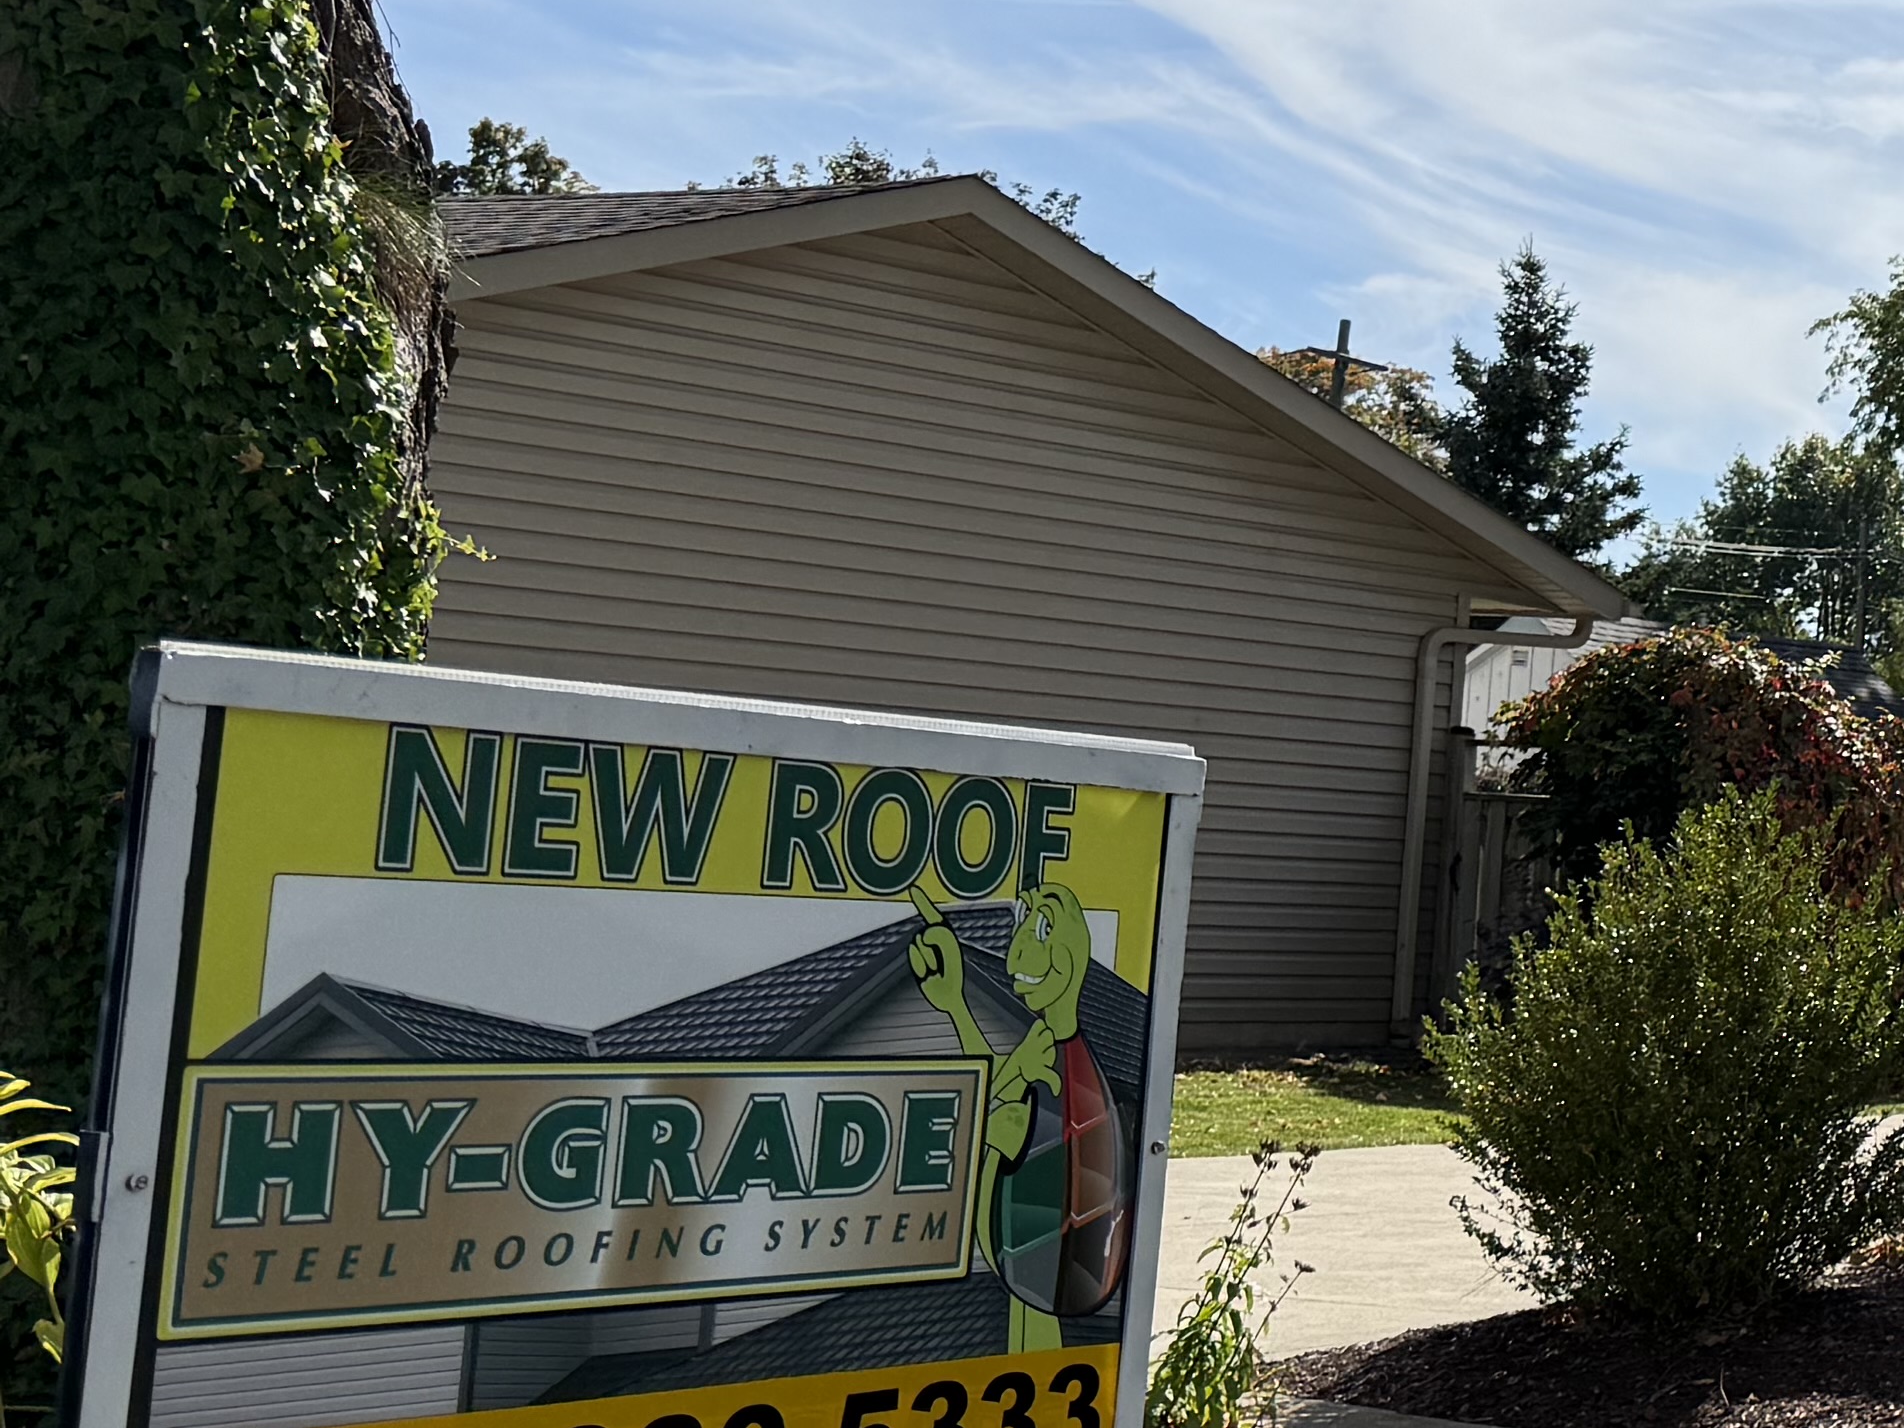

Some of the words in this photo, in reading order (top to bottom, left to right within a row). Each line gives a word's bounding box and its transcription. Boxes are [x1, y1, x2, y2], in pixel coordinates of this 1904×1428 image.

[374, 721, 737, 886] NEW
[760, 757, 1078, 901] ROOF
[211, 1090, 964, 1228] HY-GRADE
[201, 1241, 401, 1289] STEEL
[449, 1222, 727, 1275] ROOFING
[763, 1209, 950, 1251] SYSTEM
